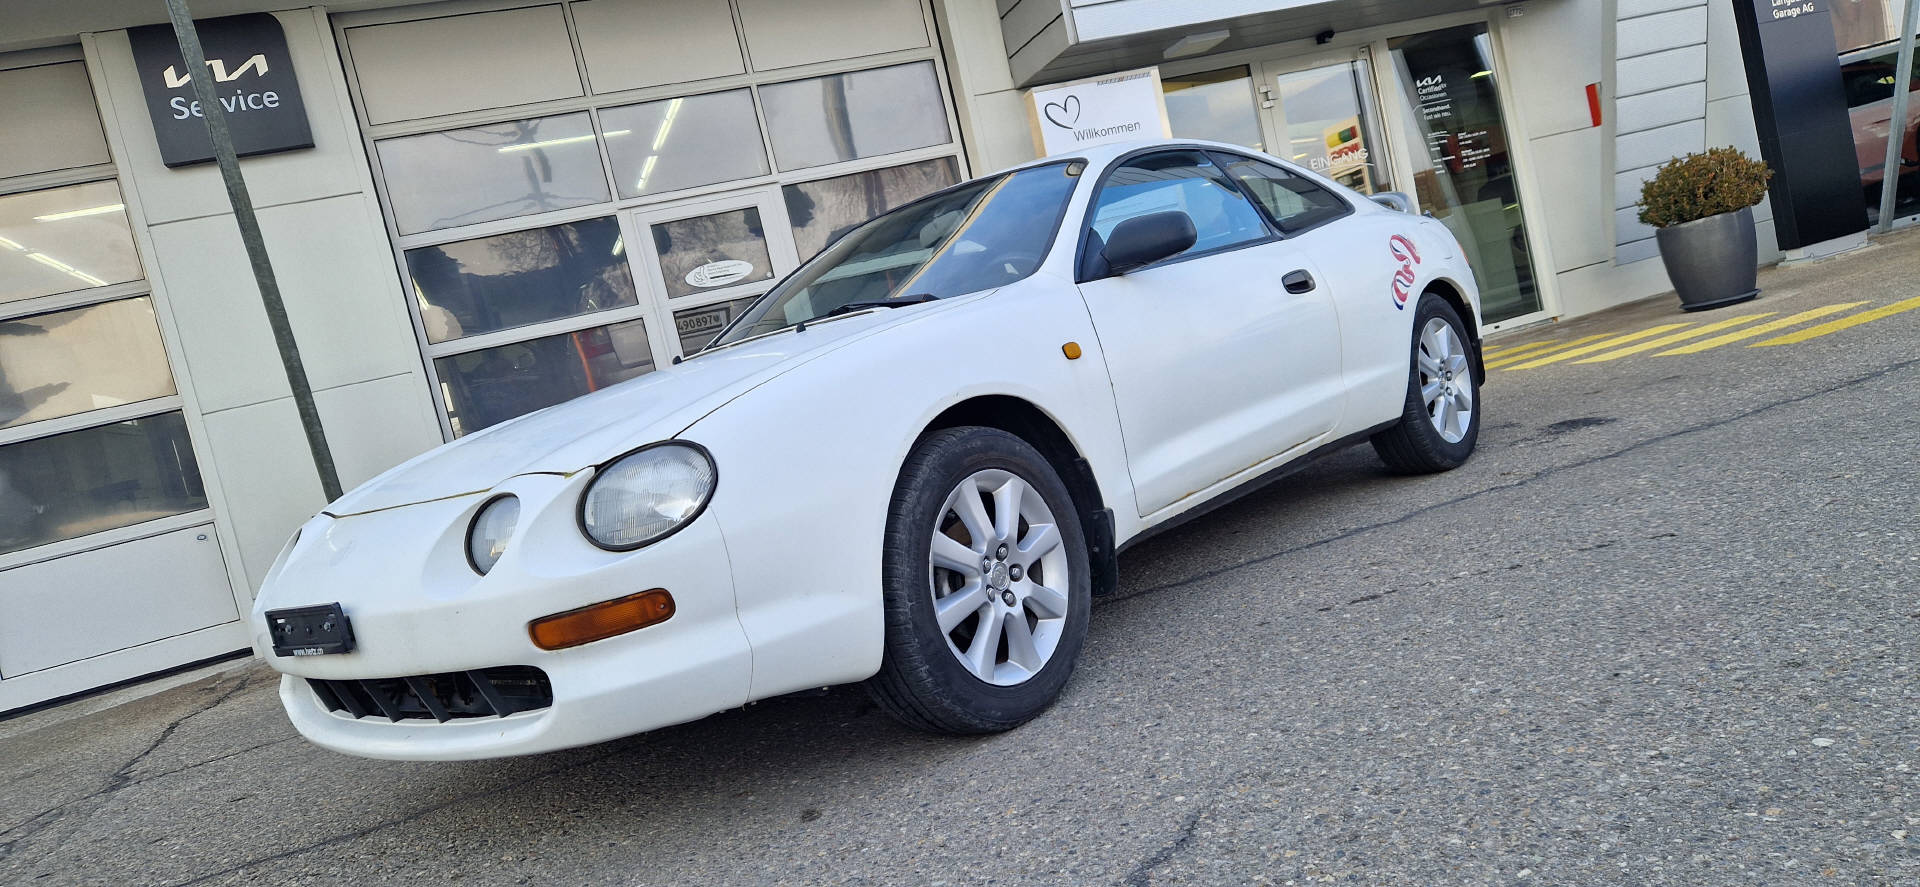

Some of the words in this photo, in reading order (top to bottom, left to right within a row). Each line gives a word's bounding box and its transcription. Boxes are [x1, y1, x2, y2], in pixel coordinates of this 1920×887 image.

[1772, 7, 1801, 19] Garage
[1802, 2, 1814, 13] AG
[170, 89, 280, 120] Sevice
[1073, 121, 1141, 142] Willkommen
[1310, 147, 1369, 170] EINGANG
